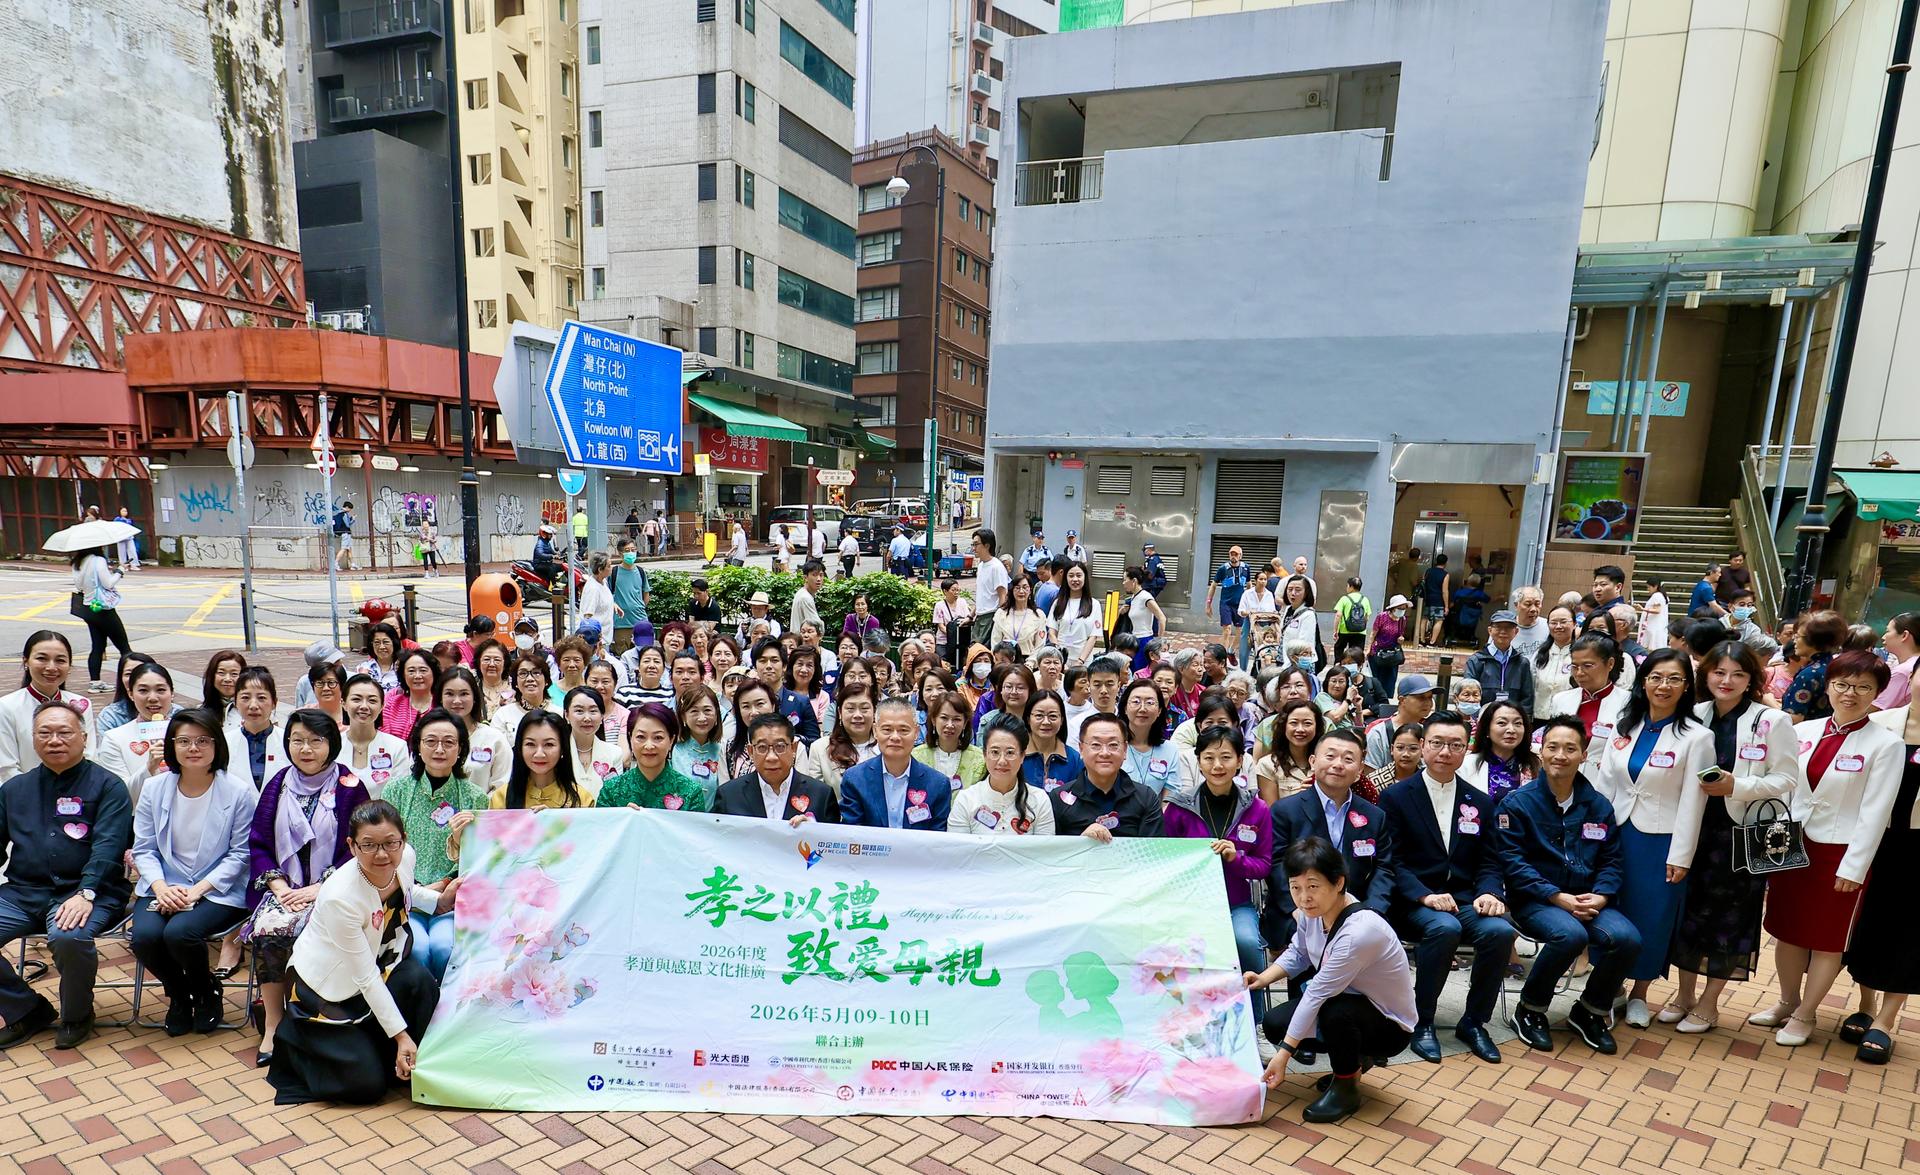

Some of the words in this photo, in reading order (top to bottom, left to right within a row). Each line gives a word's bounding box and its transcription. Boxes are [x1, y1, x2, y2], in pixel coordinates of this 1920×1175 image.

[583, 332, 601, 348] Wan
[603, 338, 621, 352] Chai
[623, 341, 636, 358] (N)
[583, 353, 626, 380] 灣仔(北)
[583, 377, 606, 393] North
[608, 382, 629, 397] Point
[583, 397, 606, 418] 北角
[584, 421, 618, 436] Kowloon
[620, 425, 633, 439] (W)
[586, 440, 627, 461] 九龍(西)
[684, 866, 889, 930] 孝之以禮
[900, 907, 944, 923] Happy
[700, 944, 767, 961] 2026年度
[782, 928, 1001, 987] 致愛母親
[624, 955, 766, 979] 孝道與感恩文化推廣
[750, 1004, 929, 1026] 2026年5月09-10日
[815, 1034, 865, 1048] 聯合主辦
[710, 1053, 750, 1063] 光大香港
[872, 1060, 897, 1071] PICC
[900, 1060, 973, 1072] 中国人民保险
[1006, 1061, 1055, 1070] 国家开发银行
